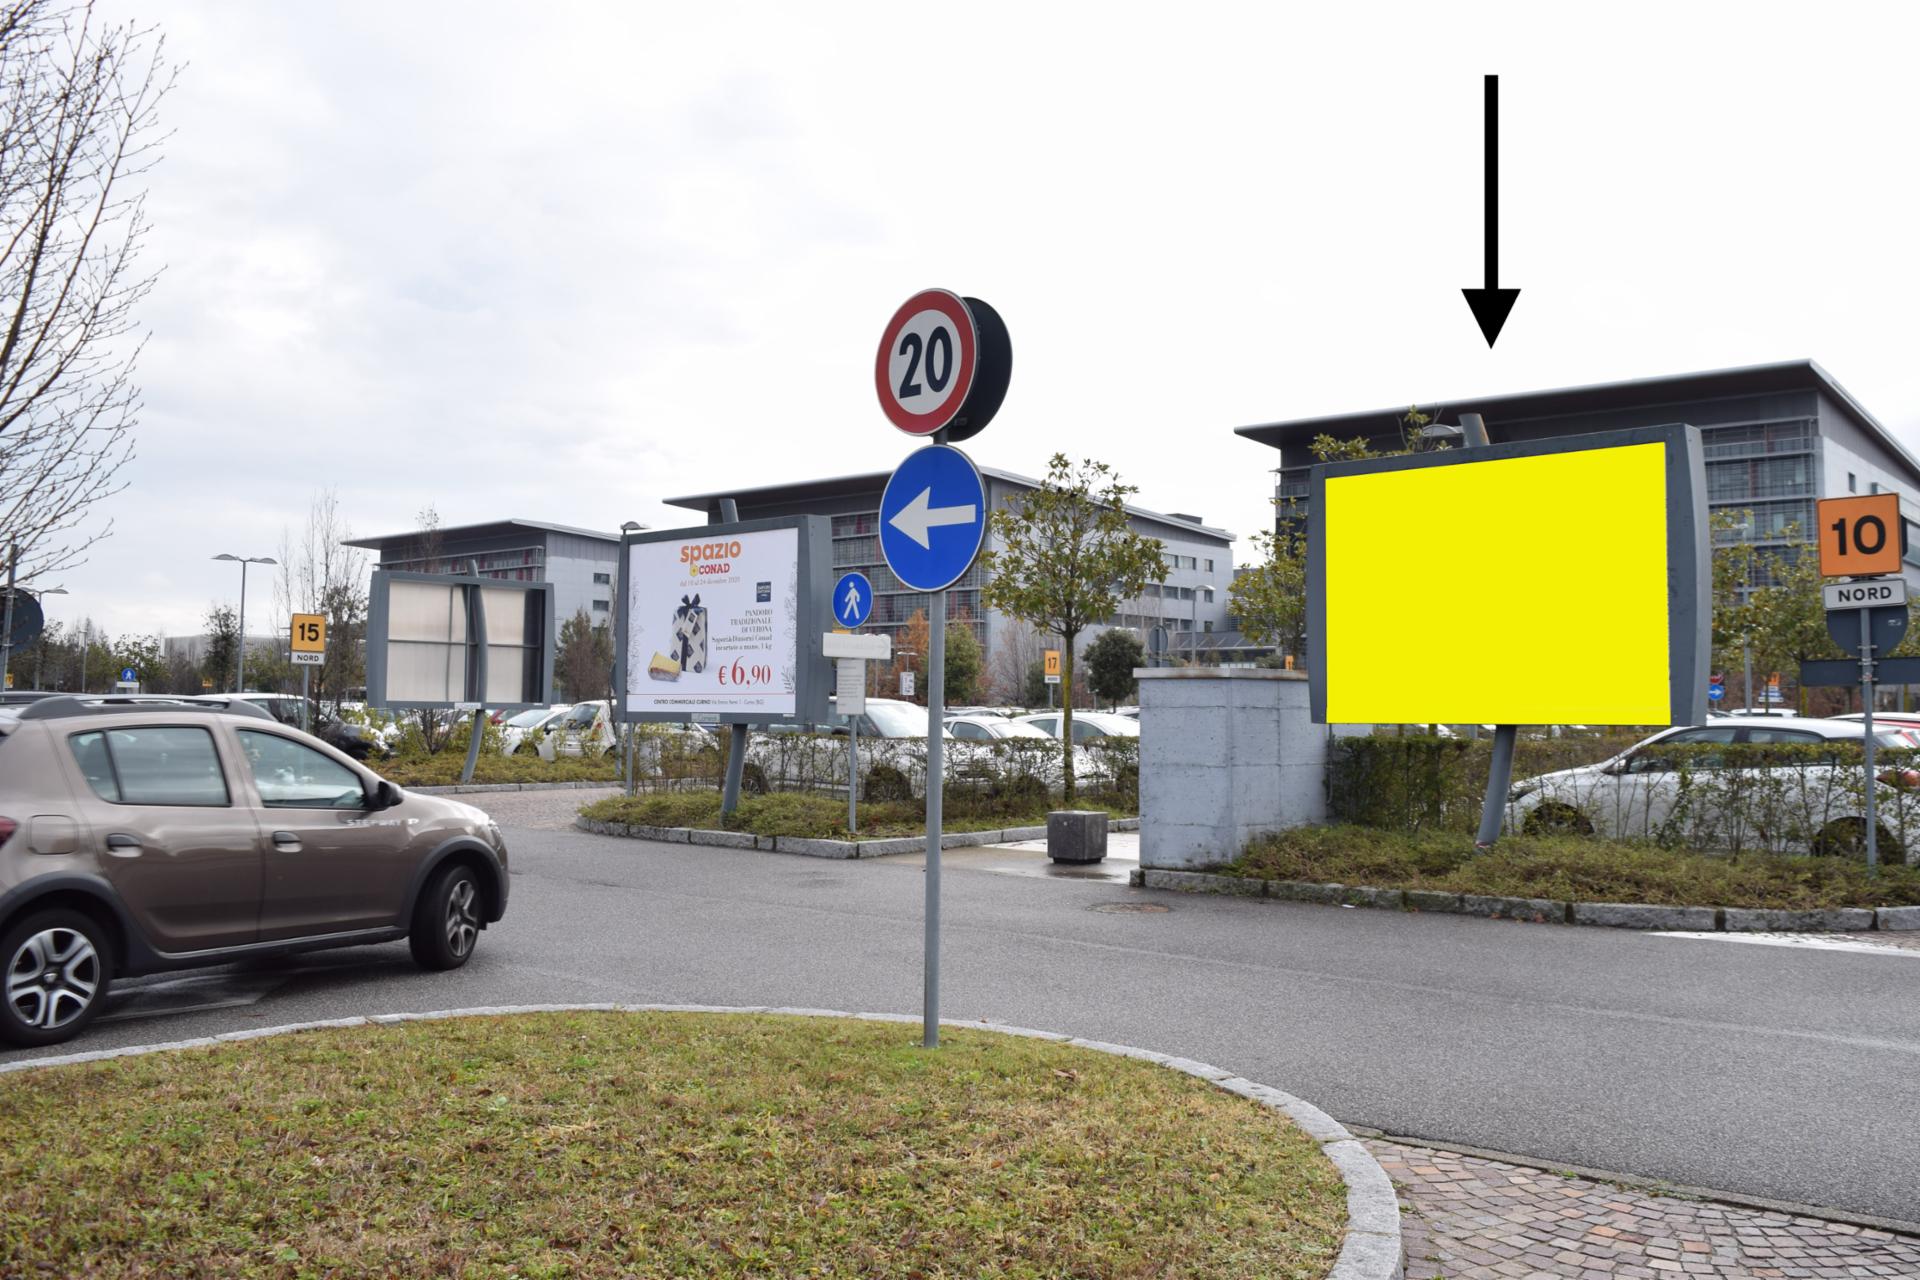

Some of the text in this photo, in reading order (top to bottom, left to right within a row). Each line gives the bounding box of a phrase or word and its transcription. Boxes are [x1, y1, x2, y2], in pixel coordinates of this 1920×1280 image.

[899, 325, 953, 399] 20
[1832, 514, 1886, 556] 10
[680, 541, 741, 565] spazio
[699, 563, 731, 575] CONAD
[1838, 586, 1892, 602] NORD
[745, 608, 773, 616] PANDORO
[730, 616, 772, 626] TRADIZIONALE
[298, 622, 320, 642] 15
[297, 654, 320, 662] NORD
[1047, 656, 1057, 669] 17
[718, 665, 727, 686] €
